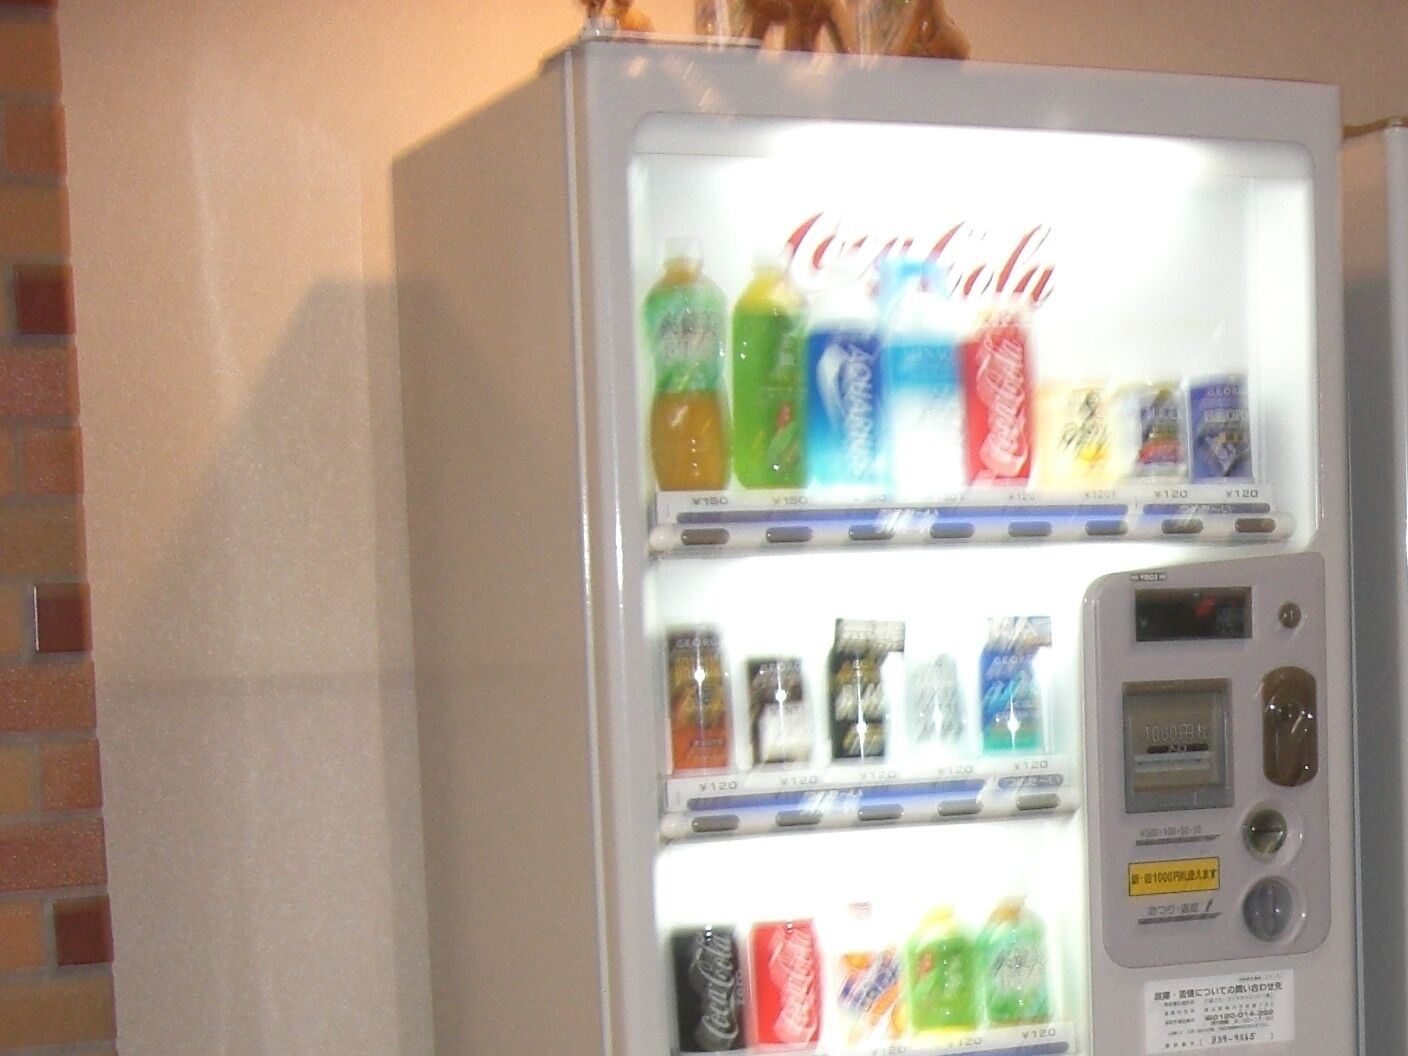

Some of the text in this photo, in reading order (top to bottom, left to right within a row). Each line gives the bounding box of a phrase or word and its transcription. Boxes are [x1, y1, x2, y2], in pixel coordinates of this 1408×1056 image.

[1154, 489, 1189, 499] ¥120
[1226, 488, 1259, 498] ¥120
[1013, 759, 1048, 770] ¥120
[699, 780, 738, 792] ¥120
[779, 774, 818, 786] ¥120
[937, 764, 974, 775] ¥120
[1021, 1027, 1057, 1039] ¥120
